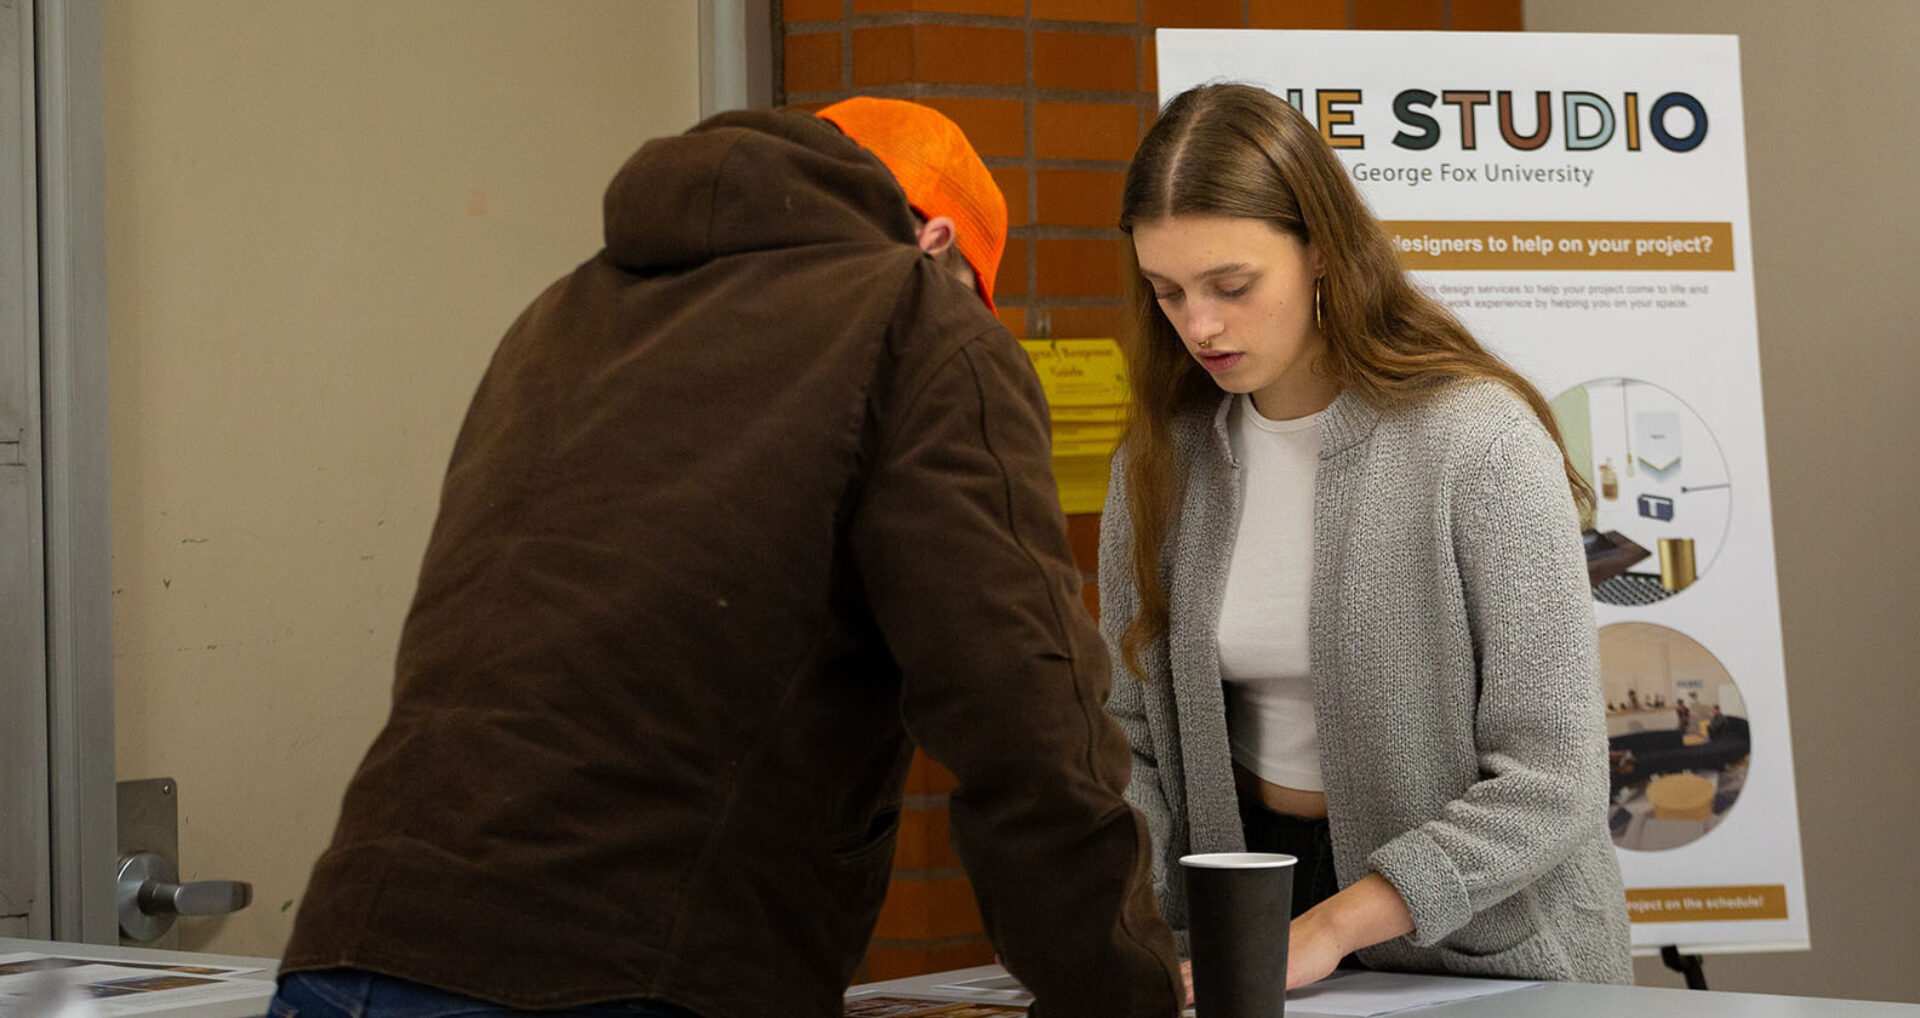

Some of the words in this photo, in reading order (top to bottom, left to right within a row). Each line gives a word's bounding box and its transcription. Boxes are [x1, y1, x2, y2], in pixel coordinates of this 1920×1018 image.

[1286, 88, 1365, 150] E
[1391, 88, 1709, 153] STUDIO
[1352, 163, 1433, 187] George
[1440, 163, 1477, 182] Fox
[1484, 163, 1595, 187] University
[1488, 235, 1508, 252] to
[1512, 235, 1554, 256] help
[1558, 238, 1583, 252] on
[1587, 238, 1632, 256] your
[1635, 235, 1714, 256] project?
[1626, 898, 1662, 913] roject
